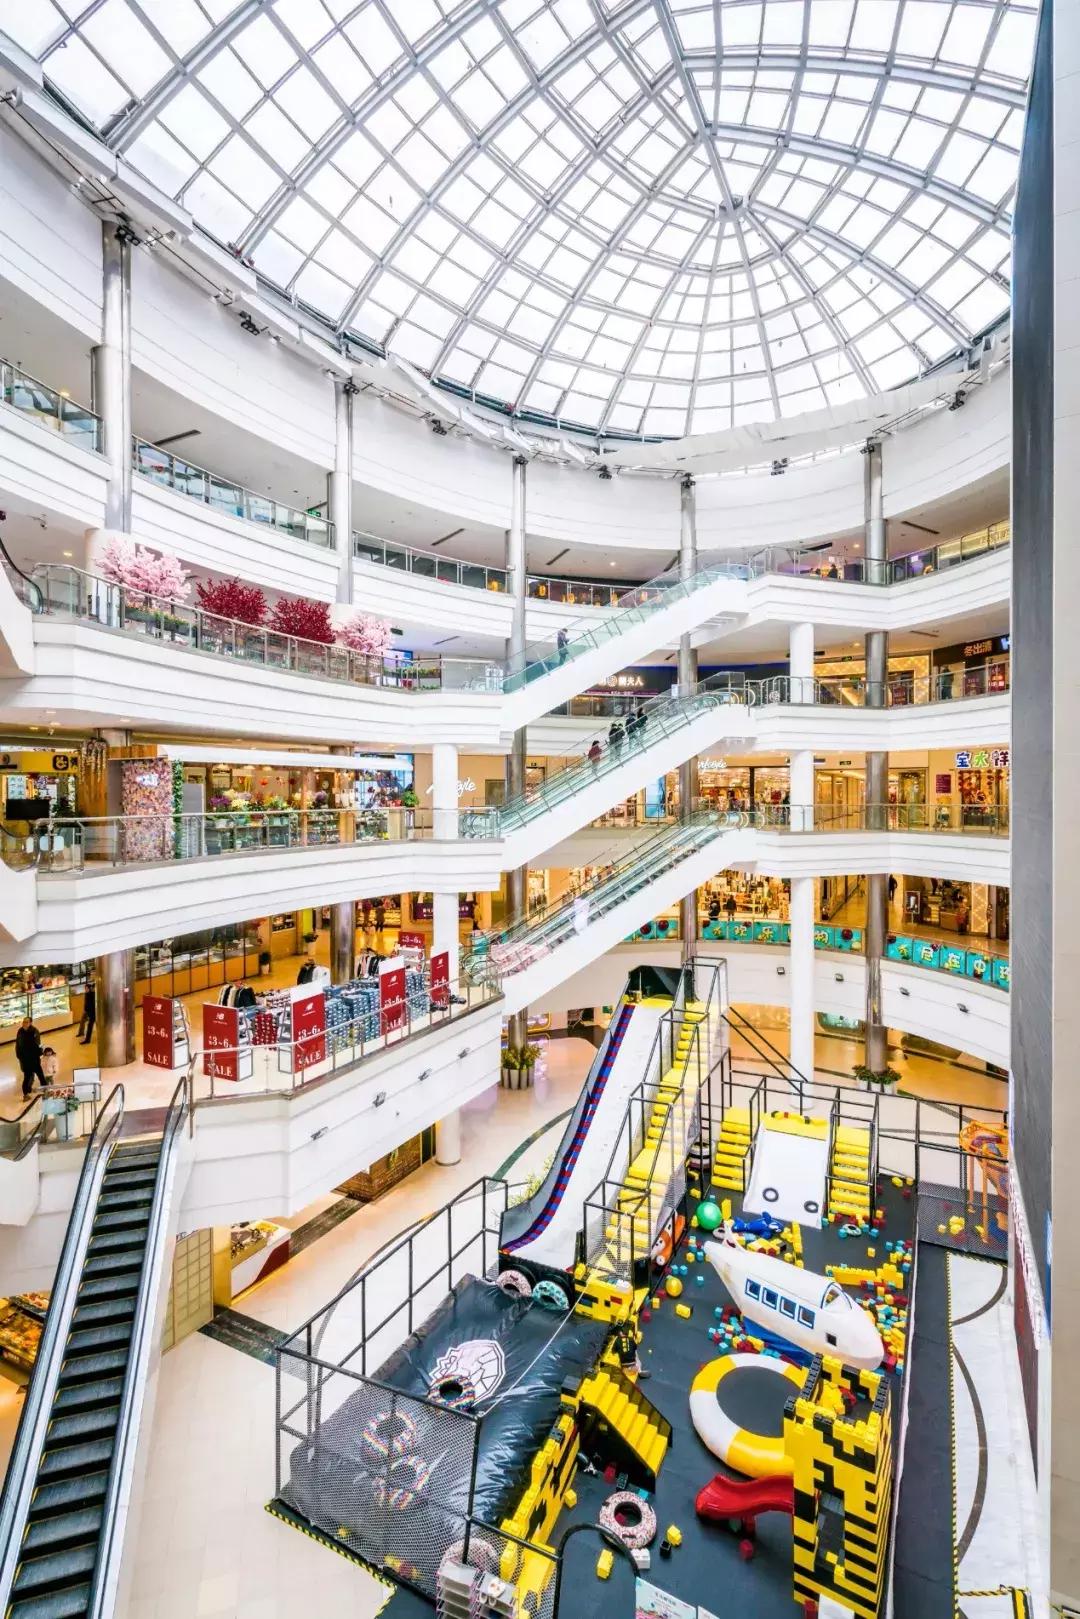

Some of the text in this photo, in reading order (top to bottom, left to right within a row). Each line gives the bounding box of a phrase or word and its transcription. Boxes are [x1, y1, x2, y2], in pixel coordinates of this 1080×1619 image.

[147, 1052, 169, 1066] SALE
[298, 1051, 321, 1066] SALE
[207, 1063, 233, 1077] SALE
